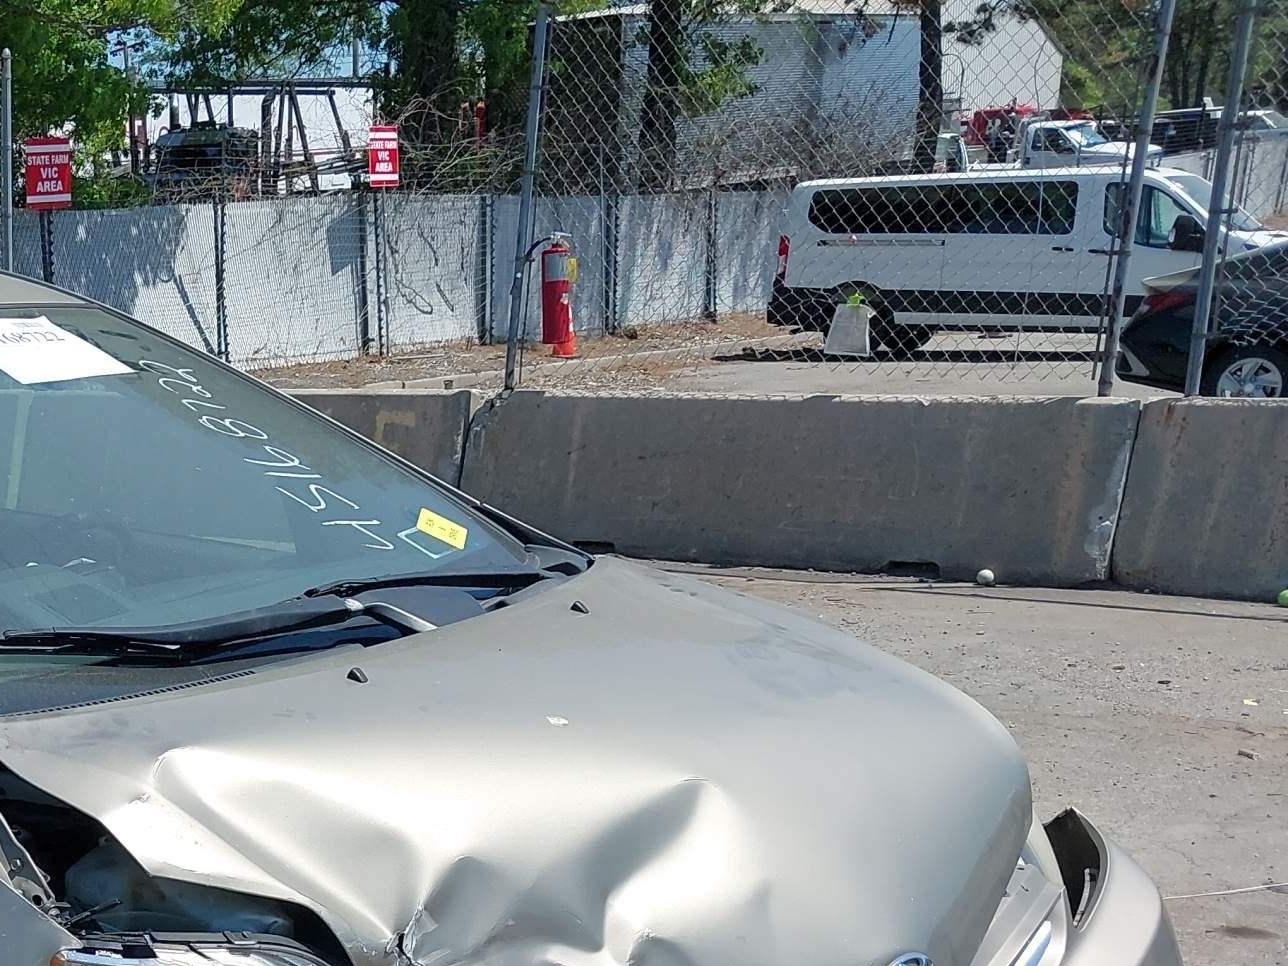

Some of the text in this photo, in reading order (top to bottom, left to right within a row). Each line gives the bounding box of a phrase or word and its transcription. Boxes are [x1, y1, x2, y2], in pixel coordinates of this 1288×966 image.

[27, 154, 69, 166] STATE FARM
[377, 150, 390, 161] VIC
[40, 167, 59, 179] VIC
[375, 162, 393, 172] AREA
[36, 180, 63, 193] AREA
[138, 359, 395, 551] 45168722
